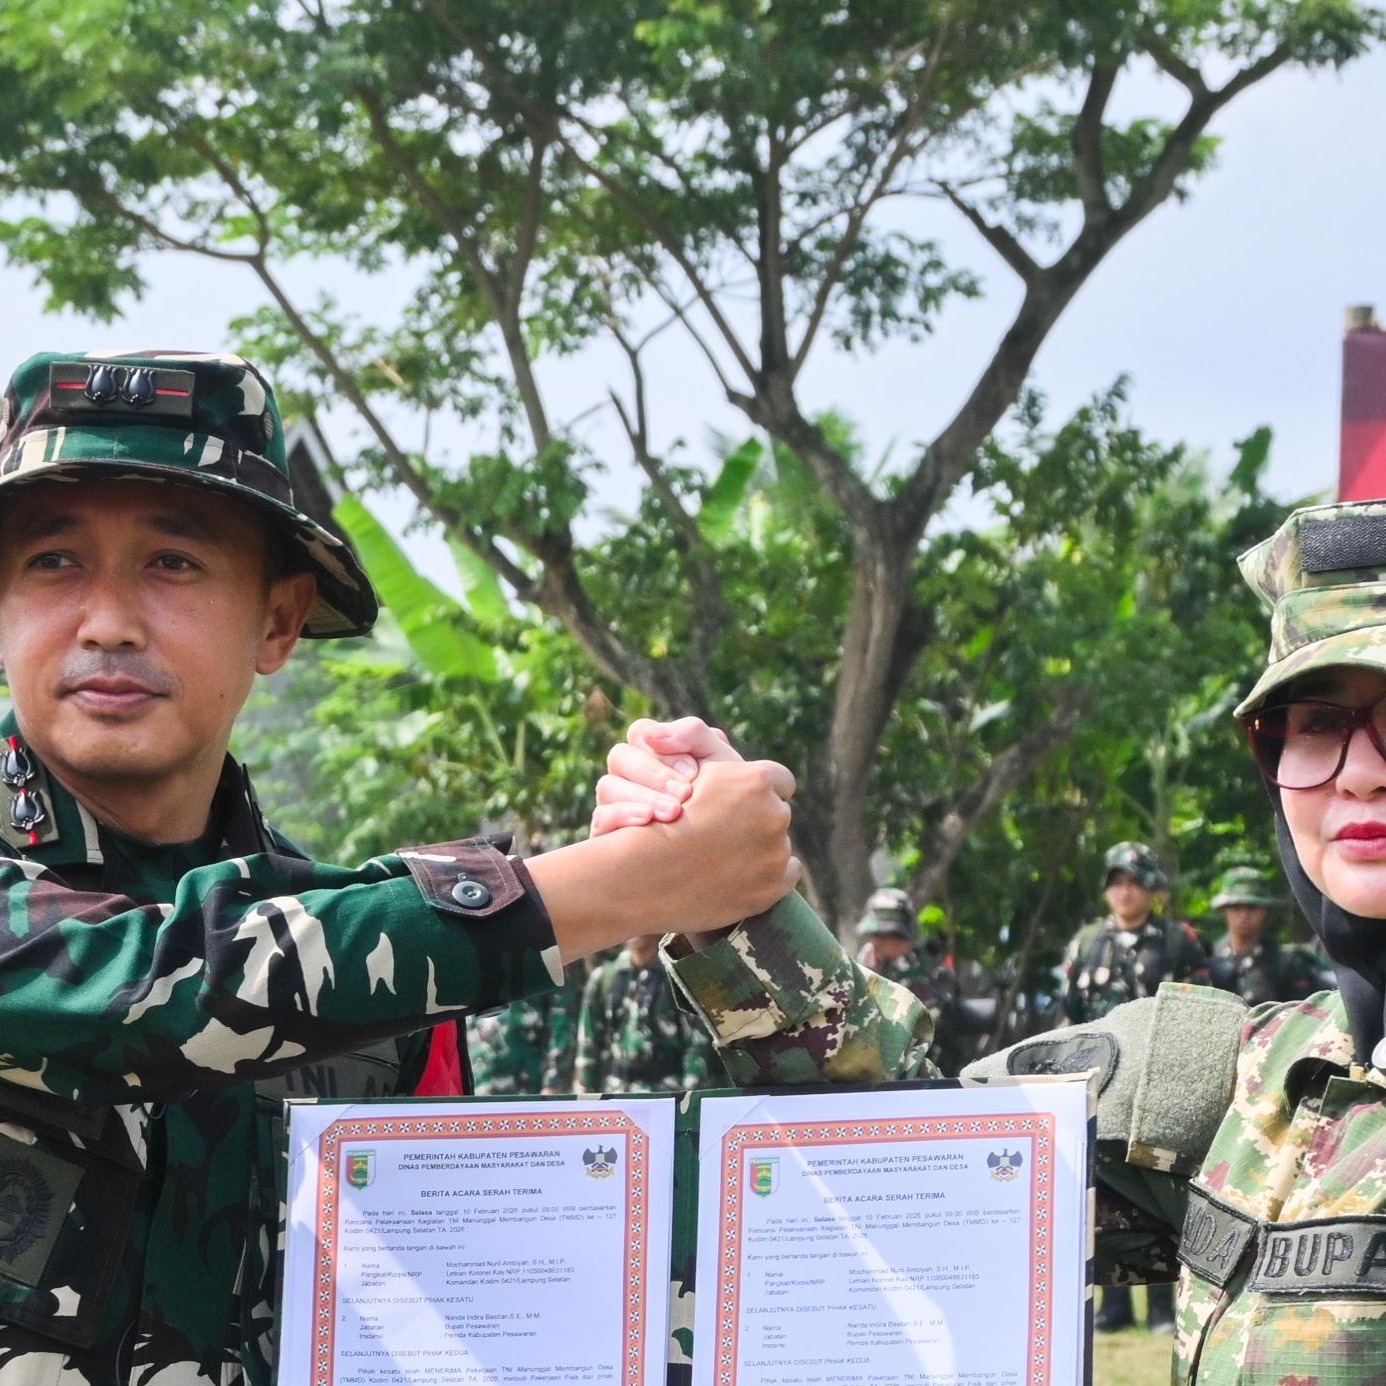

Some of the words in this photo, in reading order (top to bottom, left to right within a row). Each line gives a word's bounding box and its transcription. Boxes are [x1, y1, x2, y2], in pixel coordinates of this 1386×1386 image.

[403, 1152, 456, 1161] PEMERINTAH
[457, 1151, 507, 1160] KABUPATEN
[508, 1150, 560, 1159] PESAWARAN
[807, 1157, 859, 1167] PEMERINTAH
[860, 1155, 911, 1165] KABUPATEN
[910, 1153, 964, 1163] PESAWARAN
[398, 1163, 420, 1171] DINAS
[421, 1162, 479, 1170] PEMBERDAYAAN
[481, 1161, 529, 1169] MASYARAKAT
[823, 1167, 882, 1176] PEMBERDAYAAN
[883, 1165, 932, 1174] MASYARAKAT
[933, 1164, 948, 1172] DAN
[948, 1163, 968, 1171] DESA
[421, 1190, 450, 1198] BERITA
[451, 1189, 481, 1197] ACARA
[482, 1188, 510, 1197] SERAH
[513, 1187, 543, 1196] TERIMA
[854, 1194, 884, 1203] ACARA
[885, 1193, 913, 1202] SERAH
[914, 1191, 945, 1200] TERIMA
